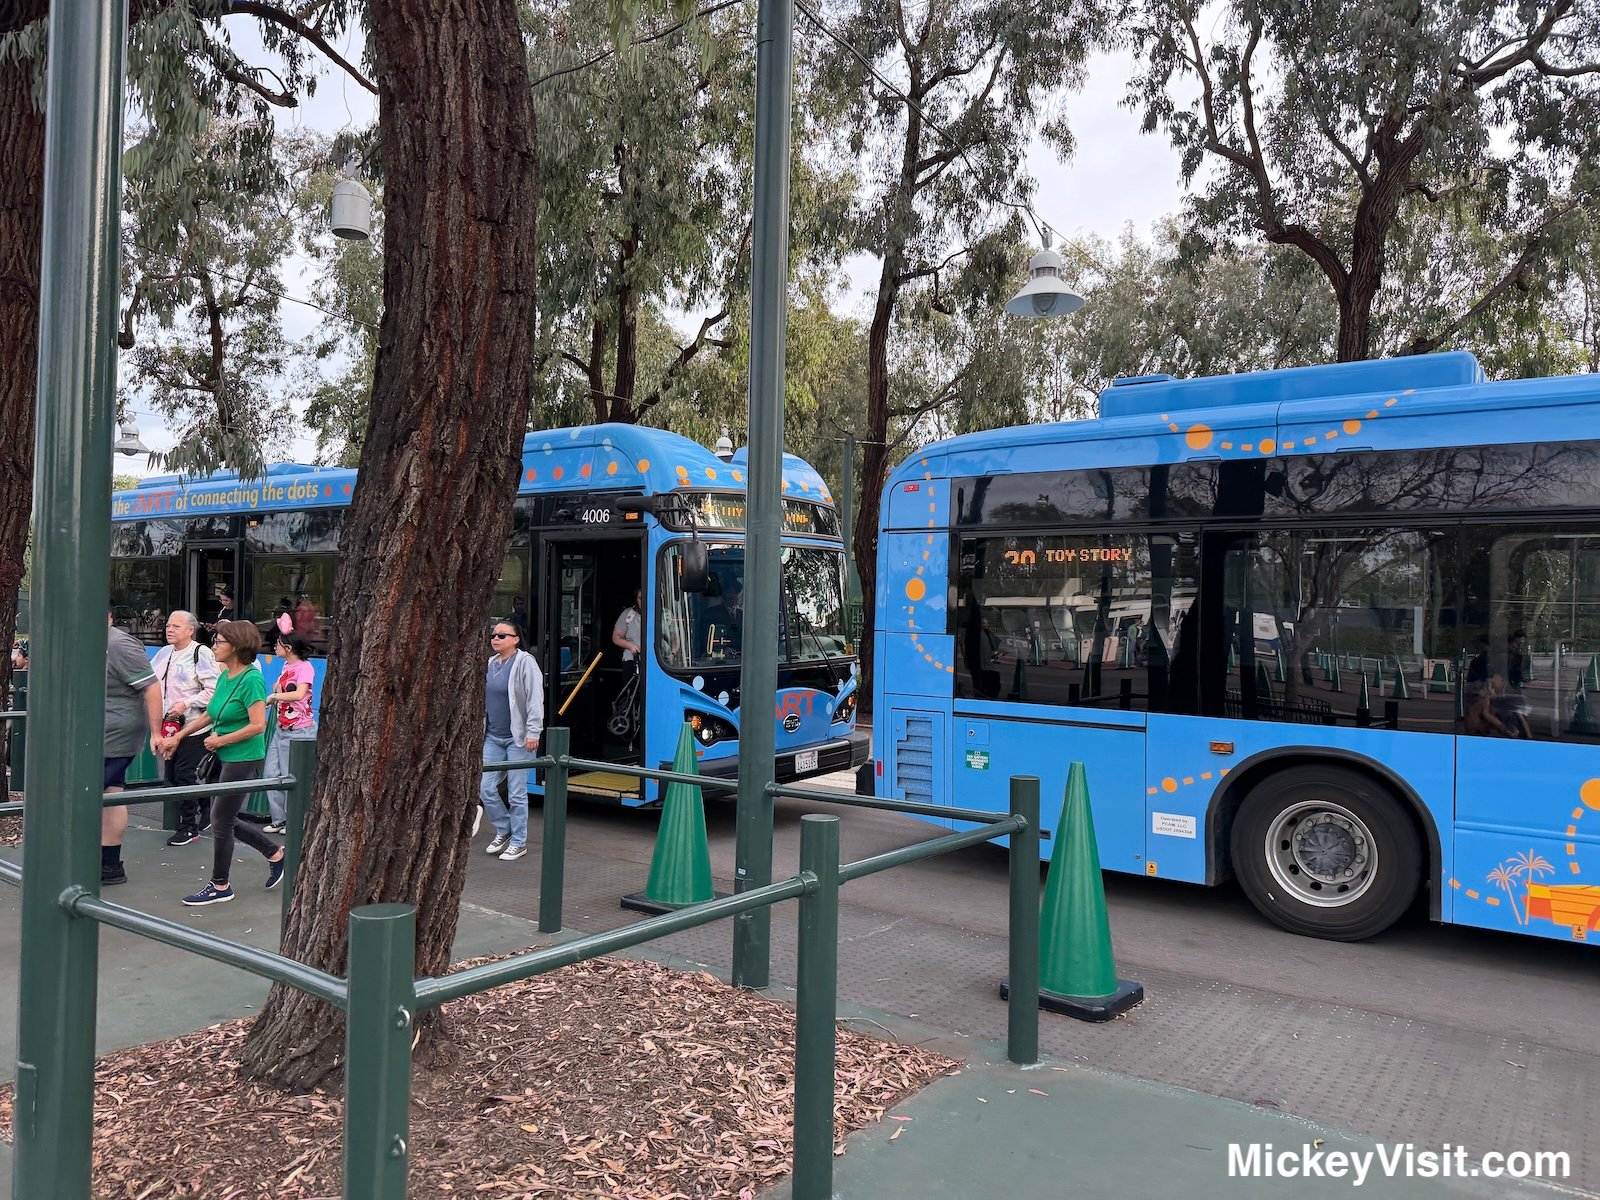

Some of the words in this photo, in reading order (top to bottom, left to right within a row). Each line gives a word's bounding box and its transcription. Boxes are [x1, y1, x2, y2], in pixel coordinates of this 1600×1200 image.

[132, 490, 177, 513] ART
[175, 489, 189, 511] of
[191, 483, 259, 508] connecting
[262, 480, 284, 501] the
[287, 479, 319, 500] dots
[581, 508, 610, 523] 4006
[1045, 549, 1077, 562] TOY
[1079, 548, 1133, 562] STORY
